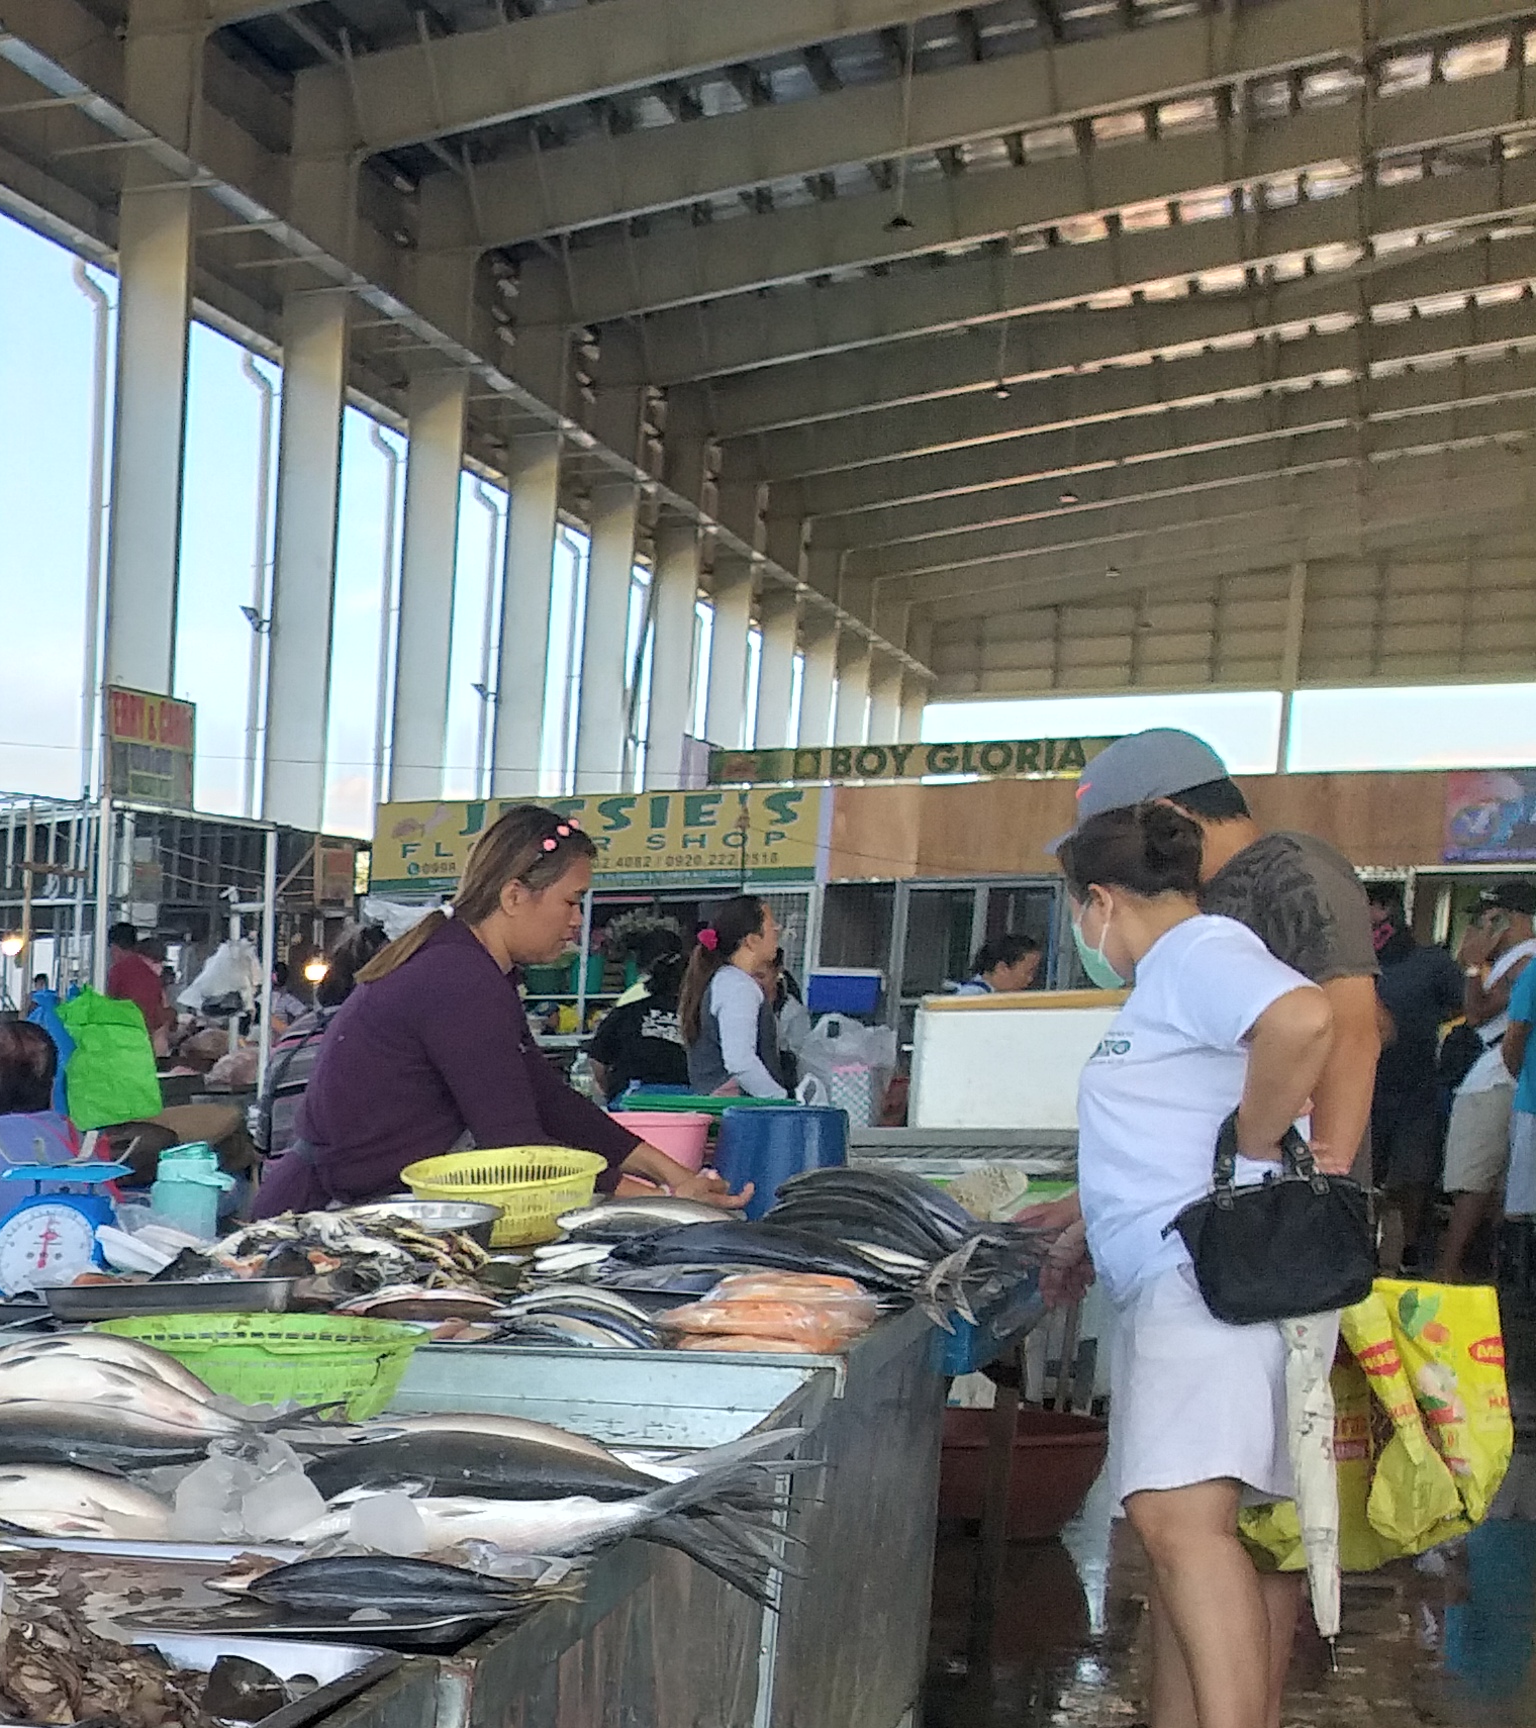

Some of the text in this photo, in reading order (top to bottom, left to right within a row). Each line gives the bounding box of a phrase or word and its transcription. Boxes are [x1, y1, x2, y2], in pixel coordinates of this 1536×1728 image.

[831, 738, 1086, 777] BOY GLORIA
[457, 791, 804, 836] JSIE'S
[646, 831, 787, 851] SHOP
